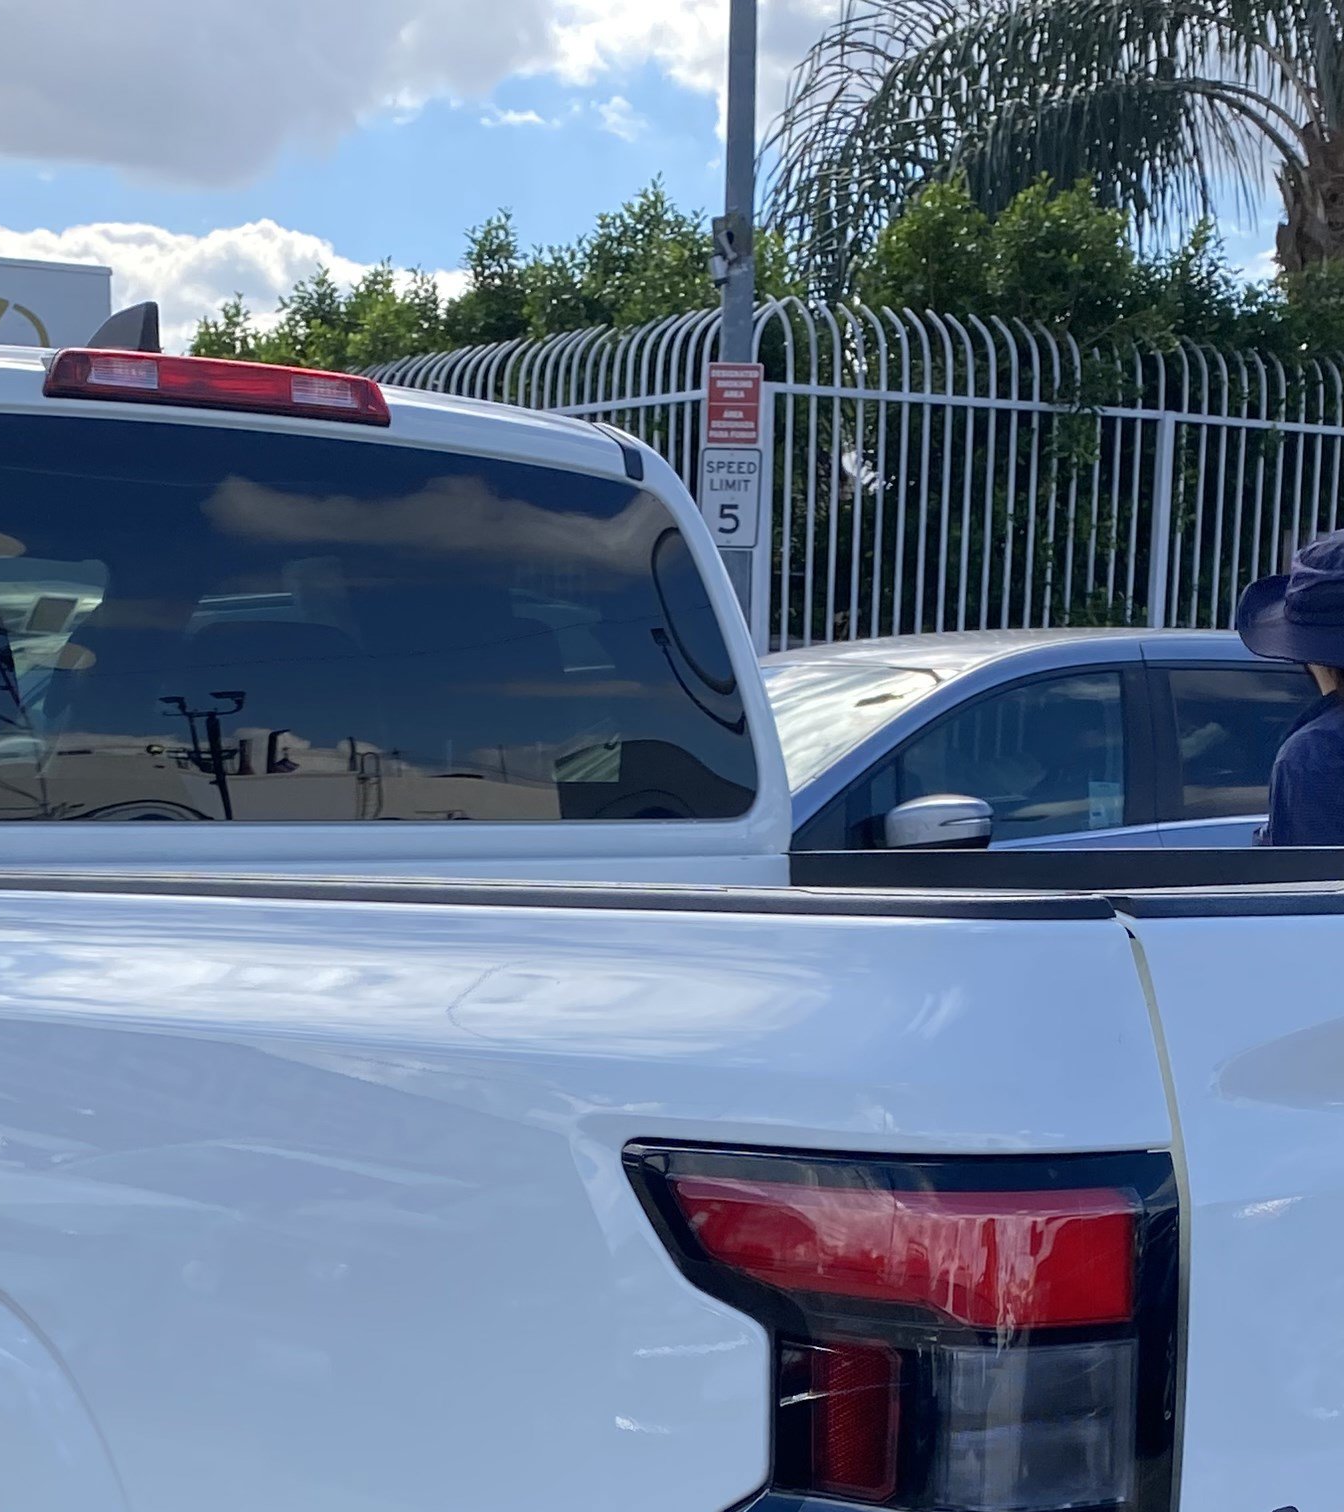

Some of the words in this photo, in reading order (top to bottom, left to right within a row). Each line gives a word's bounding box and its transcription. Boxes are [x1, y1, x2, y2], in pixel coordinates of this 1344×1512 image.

[706, 461, 757, 475] SPEED
[709, 479, 752, 492] LIMIT
[717, 504, 740, 534] 5
